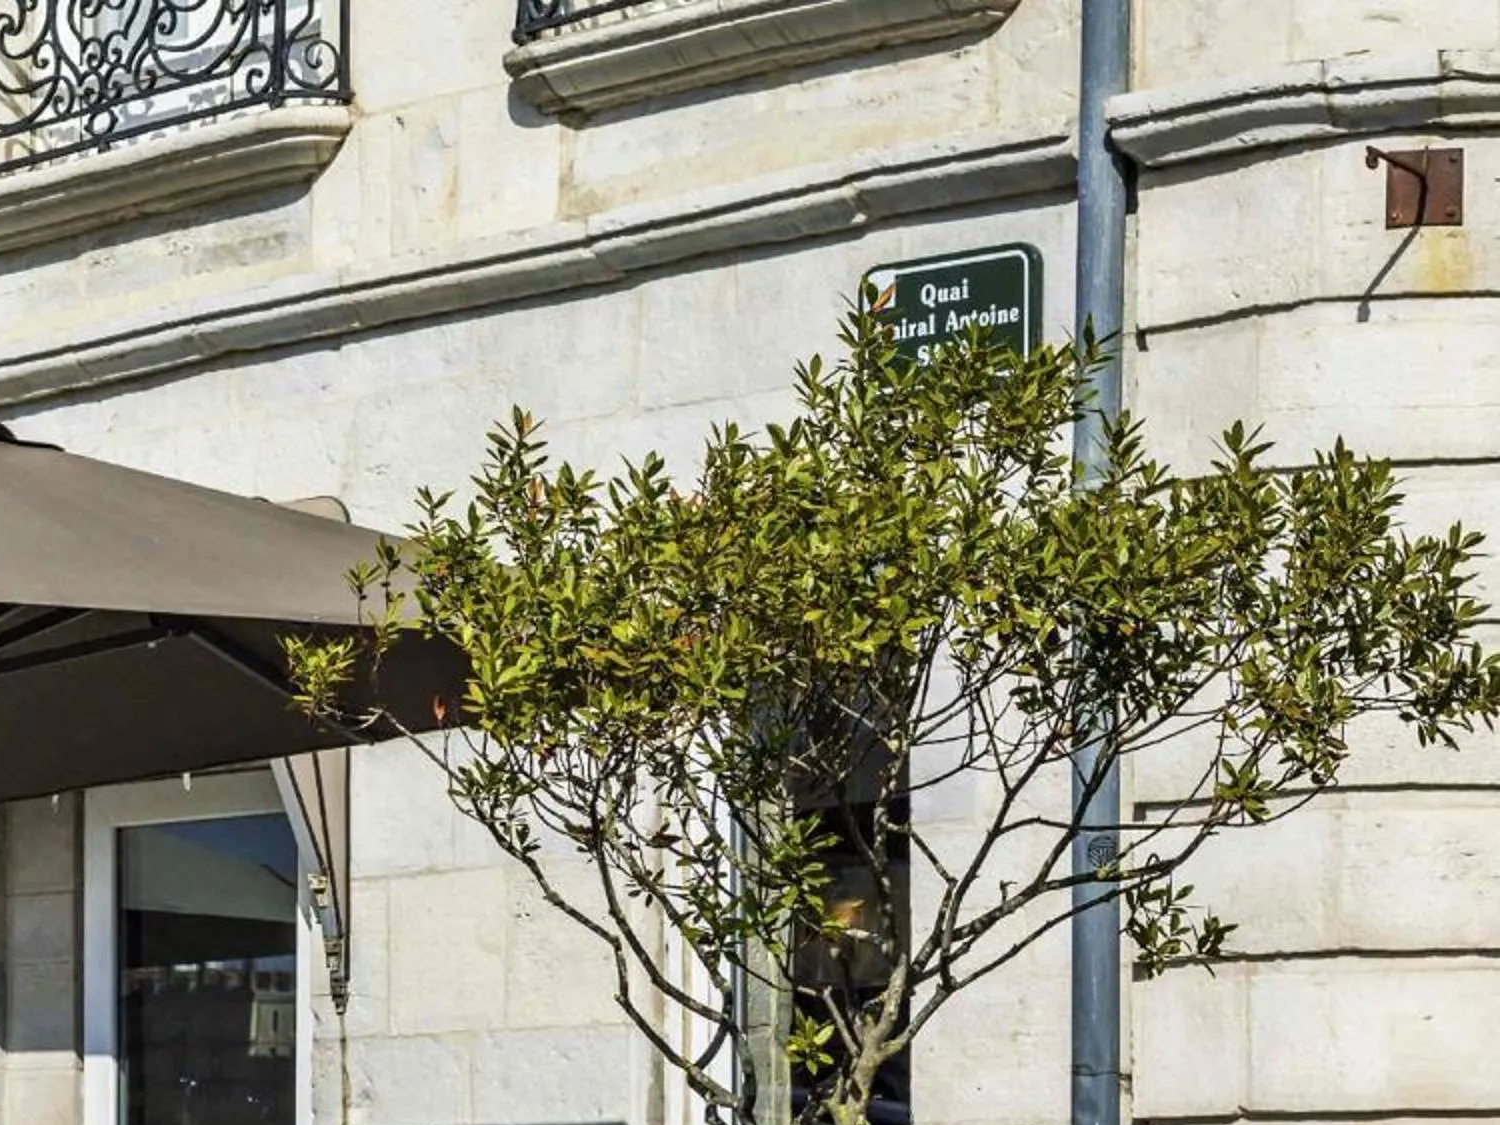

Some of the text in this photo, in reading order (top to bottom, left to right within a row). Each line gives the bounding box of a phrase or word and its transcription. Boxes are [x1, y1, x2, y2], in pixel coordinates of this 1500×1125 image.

[920, 277, 970, 308] Quai
[884, 303, 1020, 341] iral Antoine
